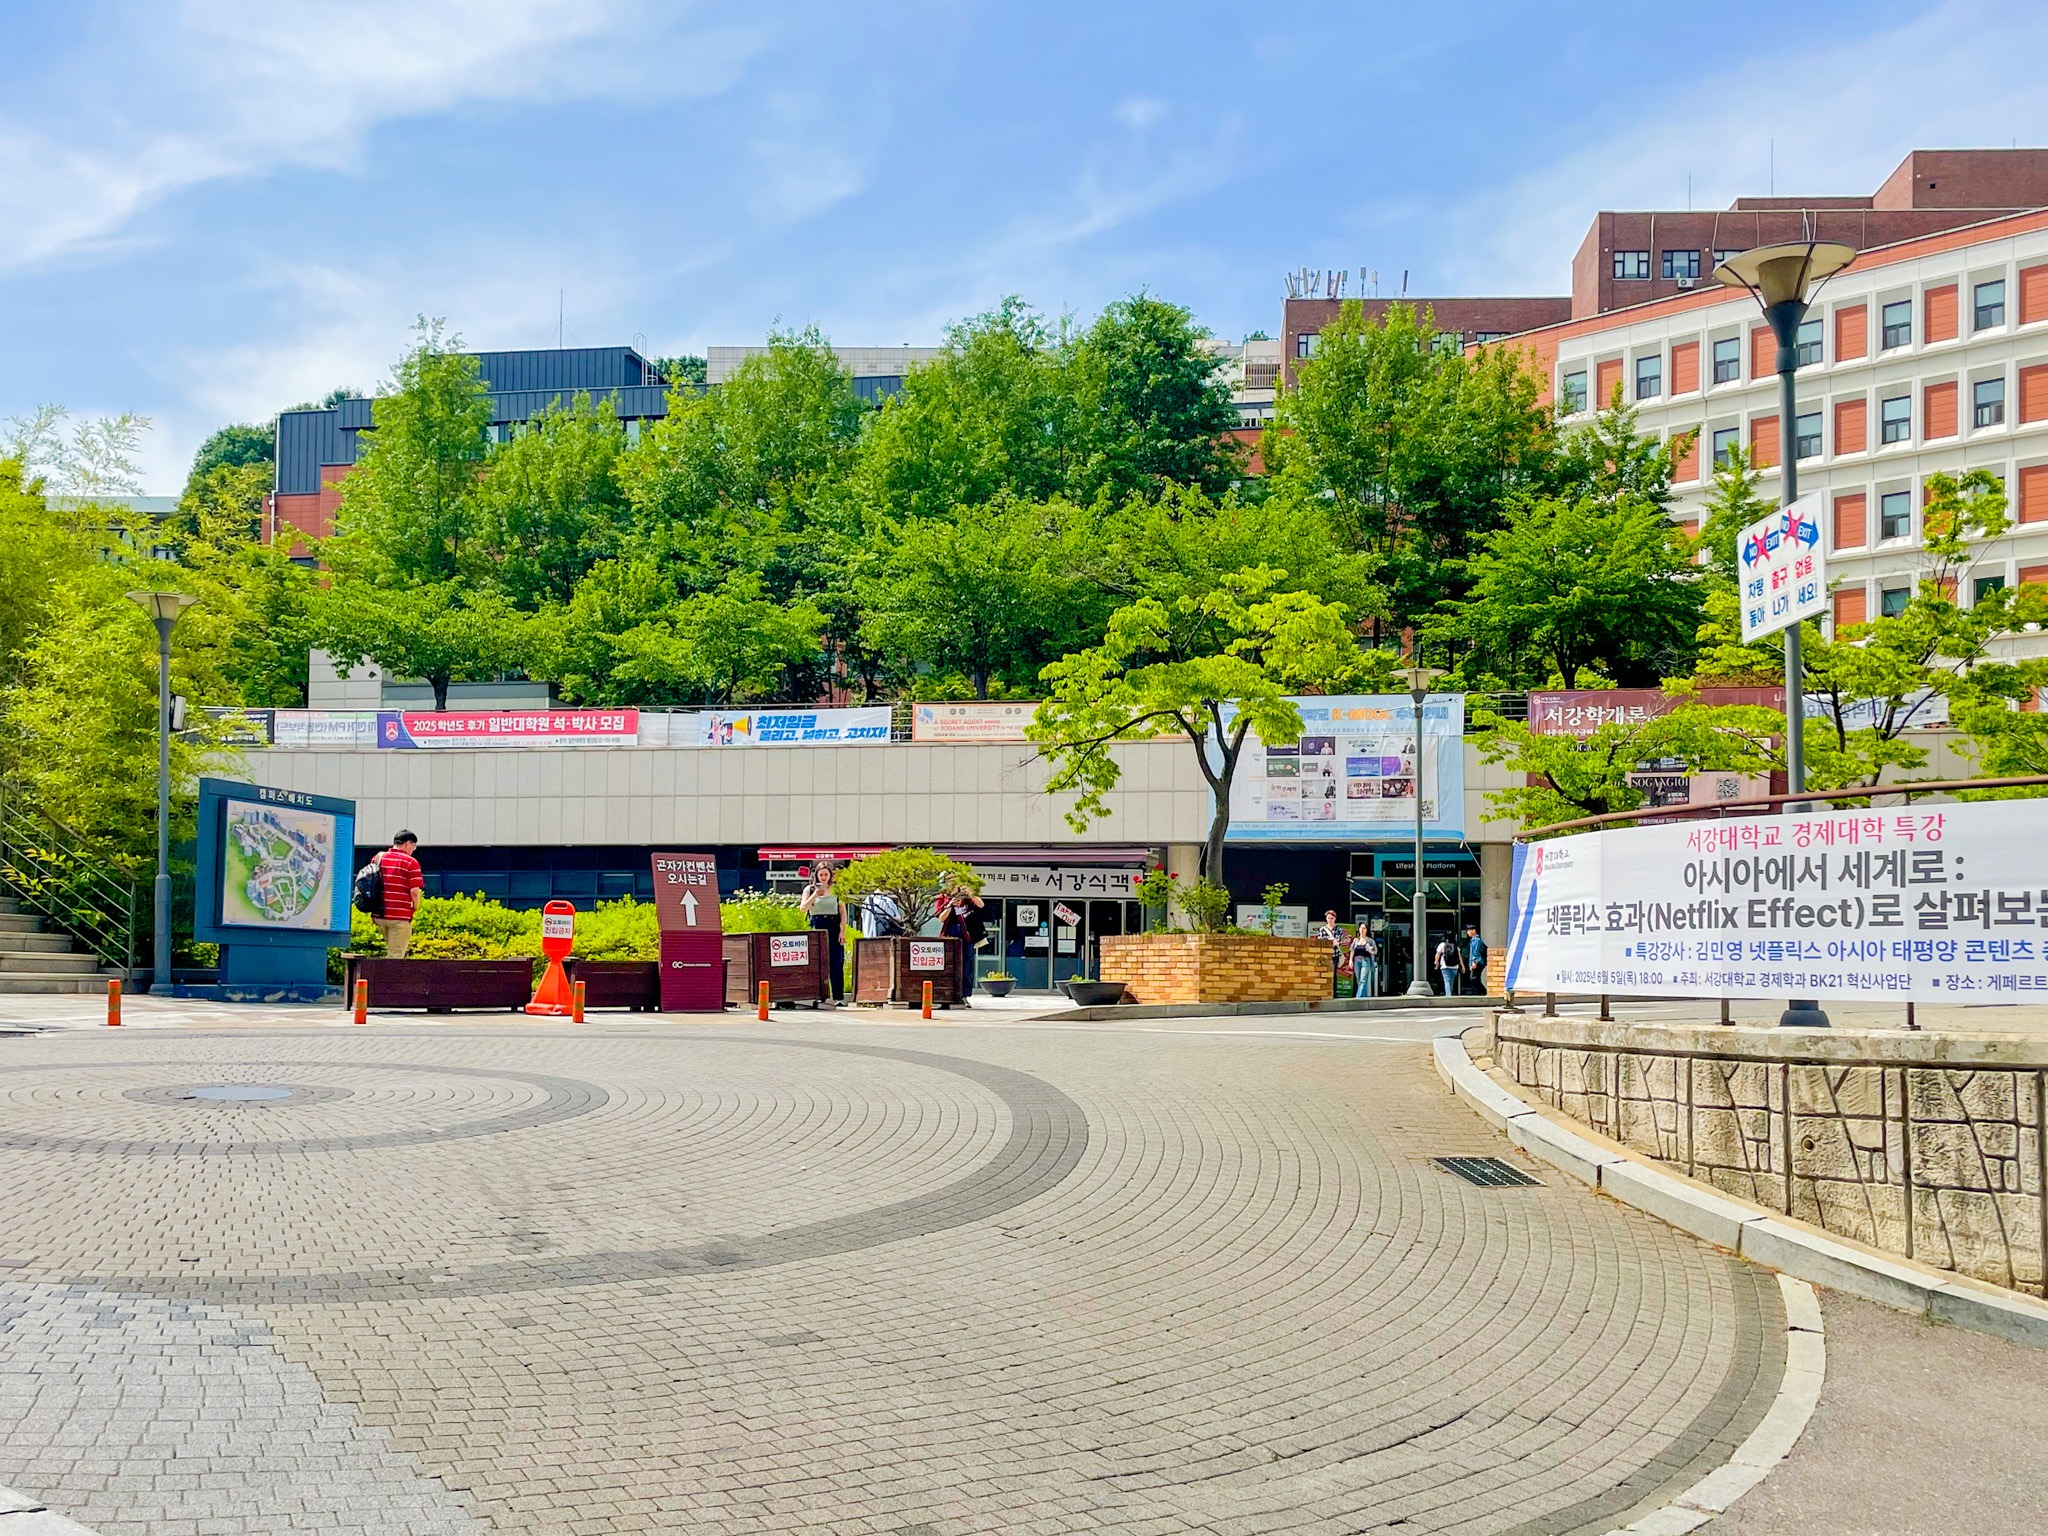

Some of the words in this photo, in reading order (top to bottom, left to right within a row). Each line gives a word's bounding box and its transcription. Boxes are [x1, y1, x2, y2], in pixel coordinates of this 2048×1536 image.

[1797, 526, 1812, 540] EXIT
[1765, 533, 1779, 549] EXIT
[1748, 578, 1764, 599] 차량
[1772, 567, 1788, 590] 출구
[1794, 555, 1815, 579] 없음.
[1750, 606, 1765, 628] 돌아
[1772, 594, 1789, 616] 나가
[1798, 582, 1818, 604] 세요!
[413, 720, 437, 731] 2025
[438, 719, 464, 731] 학년도
[467, 719, 485, 731] 후기
[489, 717, 549, 732] 일반대학원
[554, 716, 597, 731] 석·박사
[600, 716, 624, 731] 모집
[756, 715, 817, 729] 최저임금
[759, 730, 799, 742] 올리고,
[802, 729, 841, 741] 넓히고,
[845, 727, 887, 739] 고치자!
[259, 788, 285, 801] 캠퍼스
[288, 793, 313, 806] 배치도
[1686, 824, 1783, 853] 서강대학교
[1791, 816, 1886, 848] 경제대학
[1893, 813, 1947, 842] 특강
[656, 859, 716, 874] 곤자가컨벤션
[1426, 862, 1456, 870] Platform
[667, 873, 708, 886] 오시는길
[1683, 853, 1828, 895] 아시아에서
[1010, 873, 1041, 883] 즐거움
[1045, 873, 1130, 892] 서강식객
[1057, 904, 1075, 917] Take
[1546, 903, 1601, 937] 넷플릭스
[1604, 898, 1739, 935] 효과(Netflix
[1747, 894, 1904, 930] Effect)로
[1061, 914, 1076, 925] Out
[545, 926, 571, 935] 진입금지
[782, 940, 808, 948] 오토바이
[920, 946, 944, 954] 오토바이
[1695, 940, 1743, 962] 김민영
[1750, 940, 1822, 962] 넷플릭스
[1827, 940, 1887, 962] 아시아
[1892, 939, 1958, 962] 태평양
[1964, 939, 2036, 963] 콘텐츠
[772, 951, 808, 962] 진입금지
[912, 956, 944, 966] 진입금지
[1575, 971, 1596, 984] 2025년
[1597, 971, 1609, 984] 6월
[1610, 970, 1637, 985] 5일(목)
[1639, 971, 1663, 985] 18:00
[1704, 971, 1756, 987] 서강대학교
[1759, 973, 1807, 988] 경제학과
[1809, 974, 1843, 988] BK21
[1847, 973, 1912, 990] 혁신사업단
